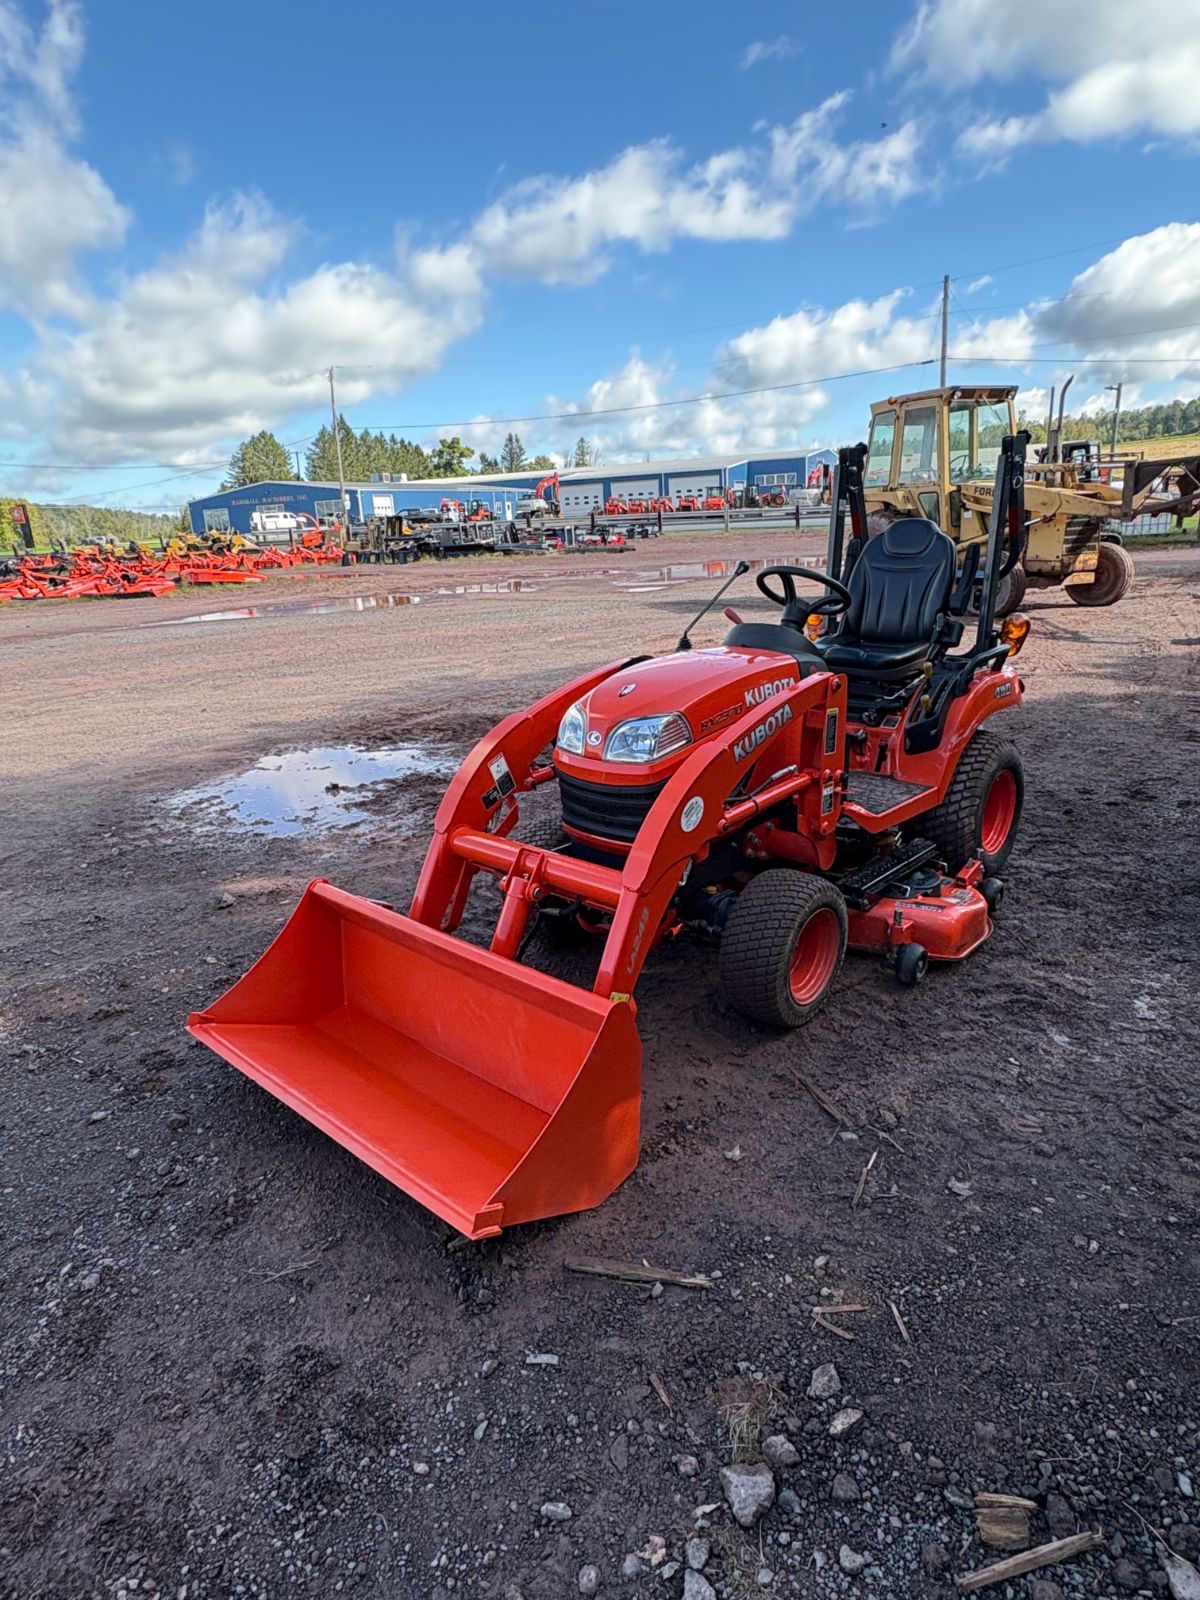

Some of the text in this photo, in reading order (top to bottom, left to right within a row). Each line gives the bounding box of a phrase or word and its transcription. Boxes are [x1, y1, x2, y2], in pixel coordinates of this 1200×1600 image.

[973, 486, 995, 497] FOR
[744, 677, 795, 708] KUBOTA
[733, 704, 793, 763] KUBOTA
